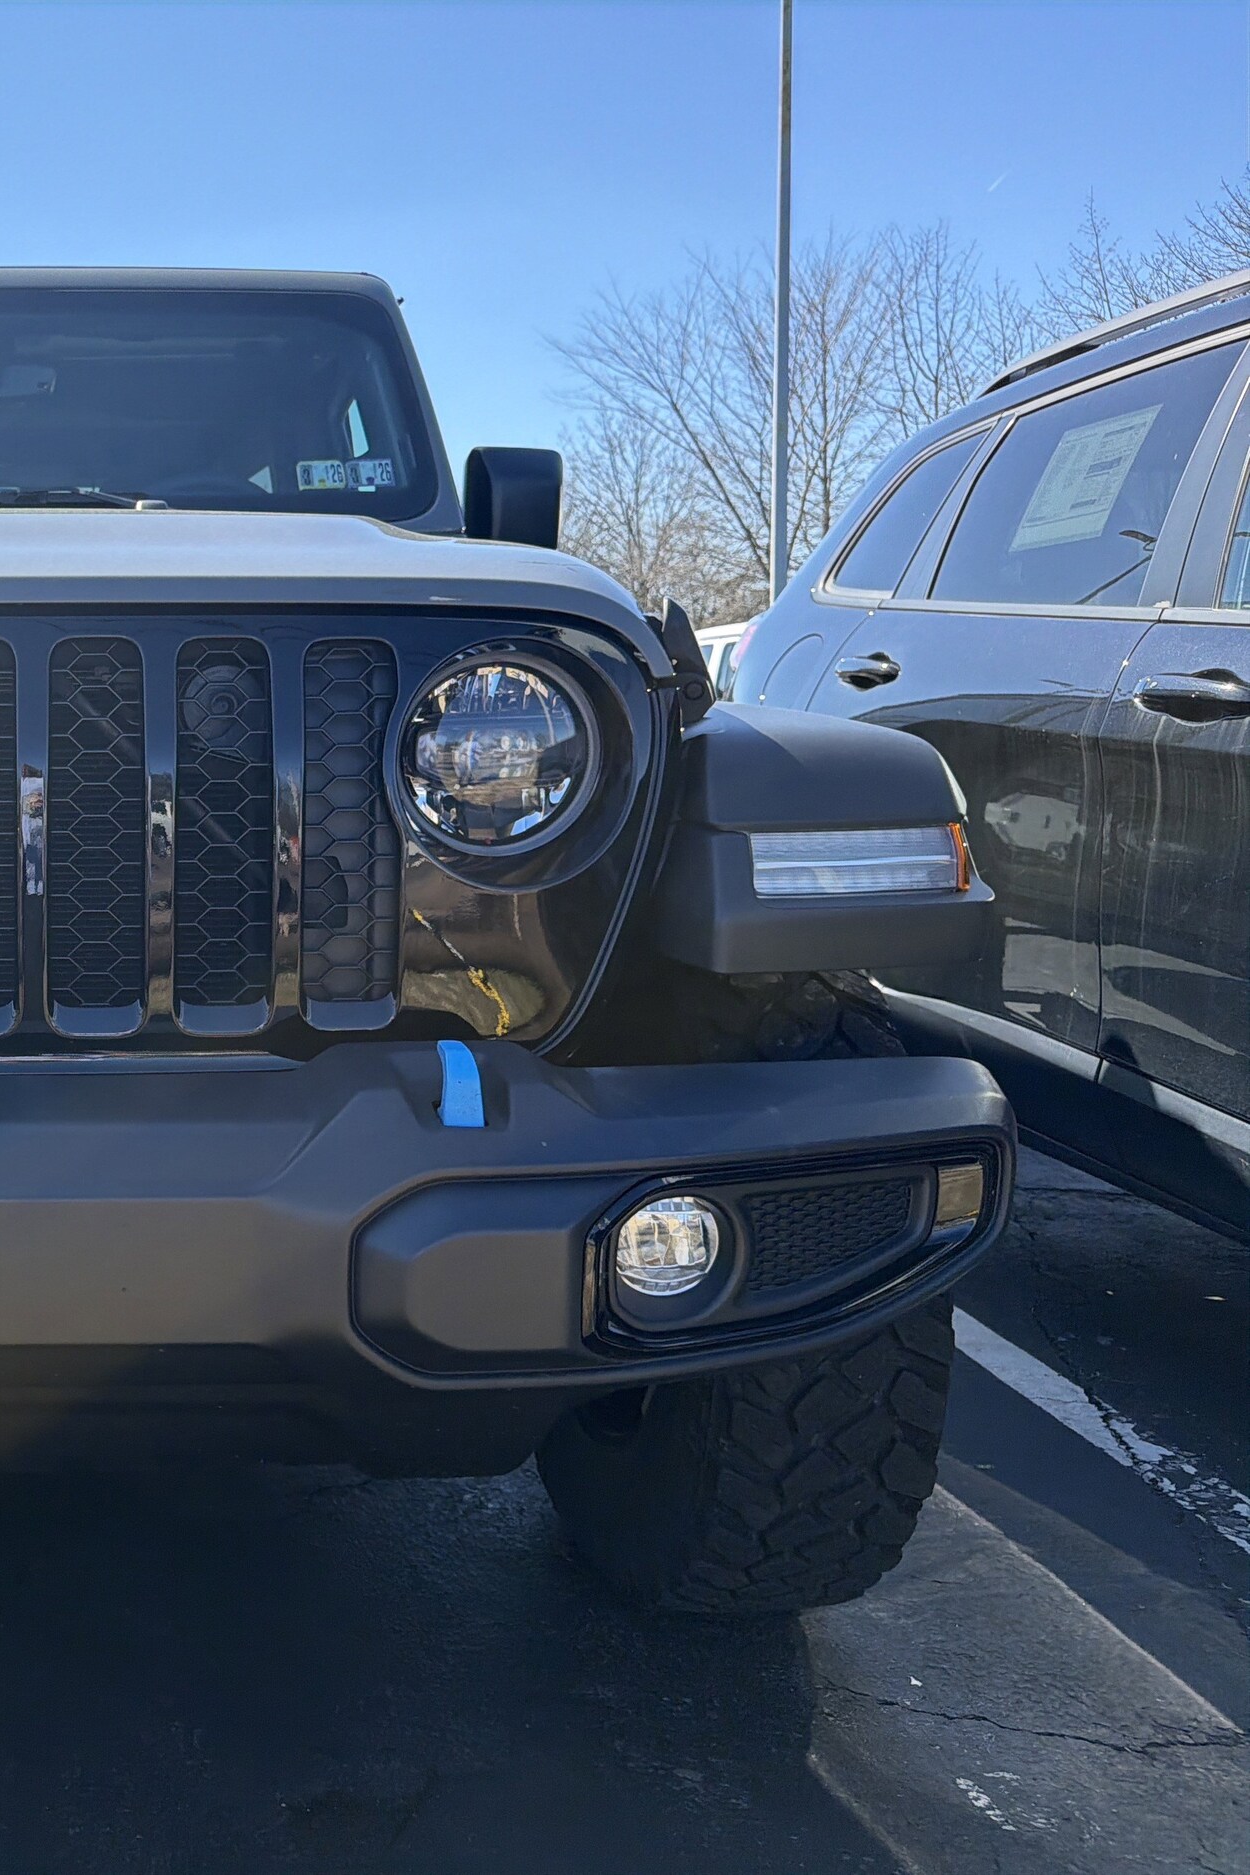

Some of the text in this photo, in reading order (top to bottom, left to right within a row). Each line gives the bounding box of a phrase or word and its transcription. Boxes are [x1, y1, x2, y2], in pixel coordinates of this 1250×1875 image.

[302, 464, 343, 486] 3 26
[378, 462, 392, 482] 26
